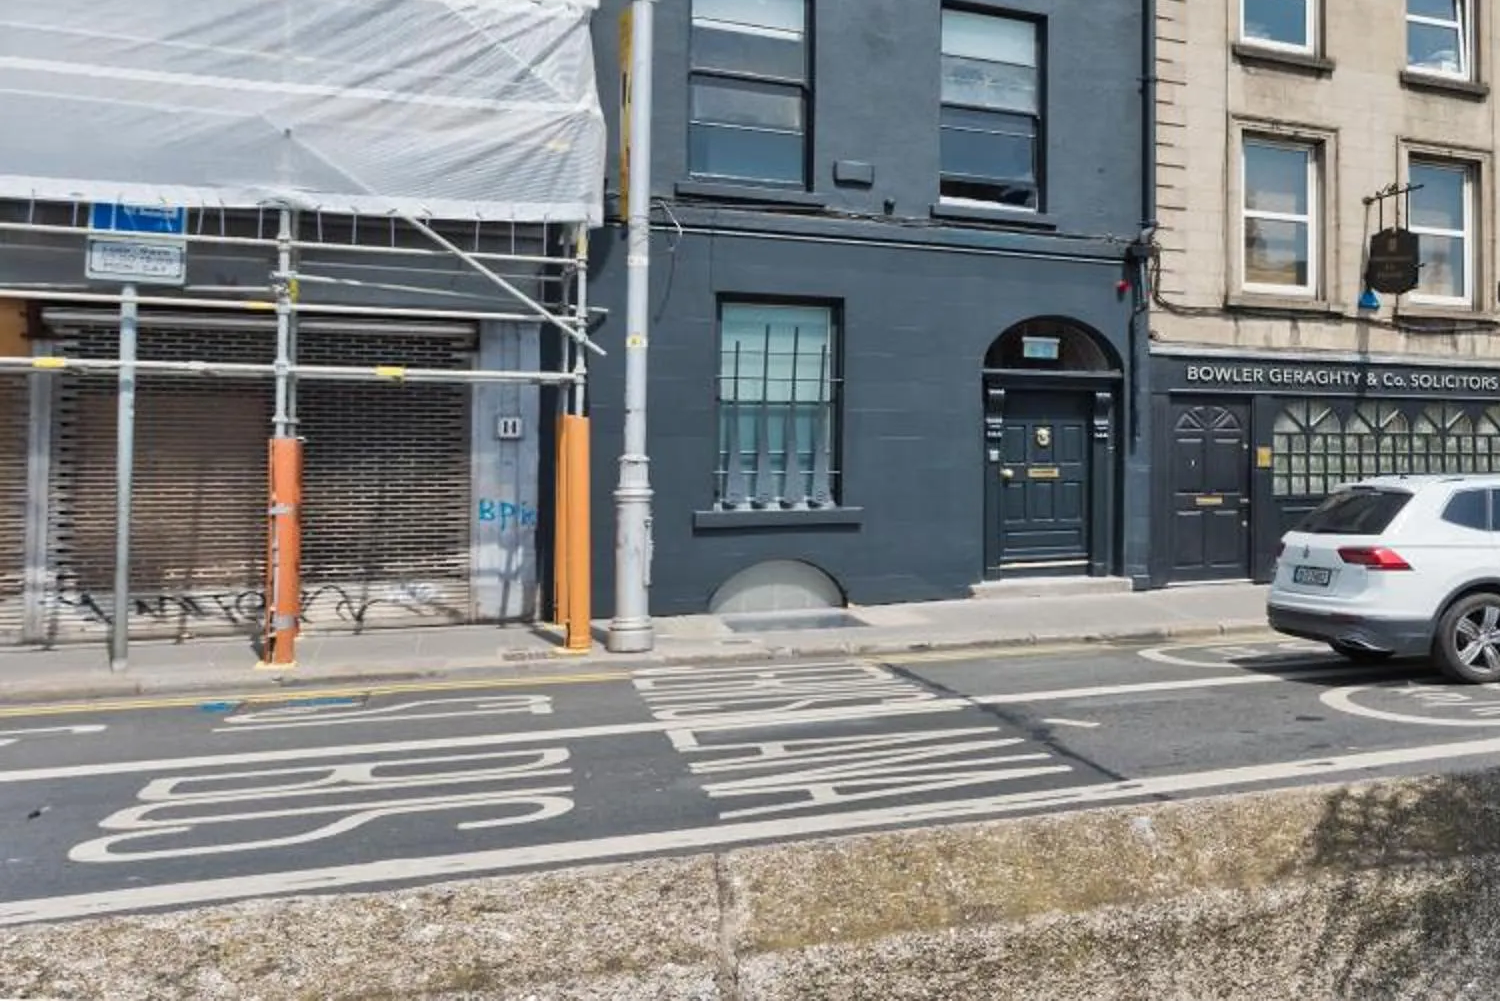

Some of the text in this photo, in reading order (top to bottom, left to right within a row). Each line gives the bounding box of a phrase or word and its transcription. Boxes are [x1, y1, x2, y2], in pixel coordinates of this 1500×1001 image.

[1187, 366, 1264, 383] BOWLER
[1269, 368, 1361, 387] GERAGHTY
[1366, 372, 1378, 387] &
[1411, 373, 1499, 390] SOLICITORS
[67, 746, 575, 863] BUS
